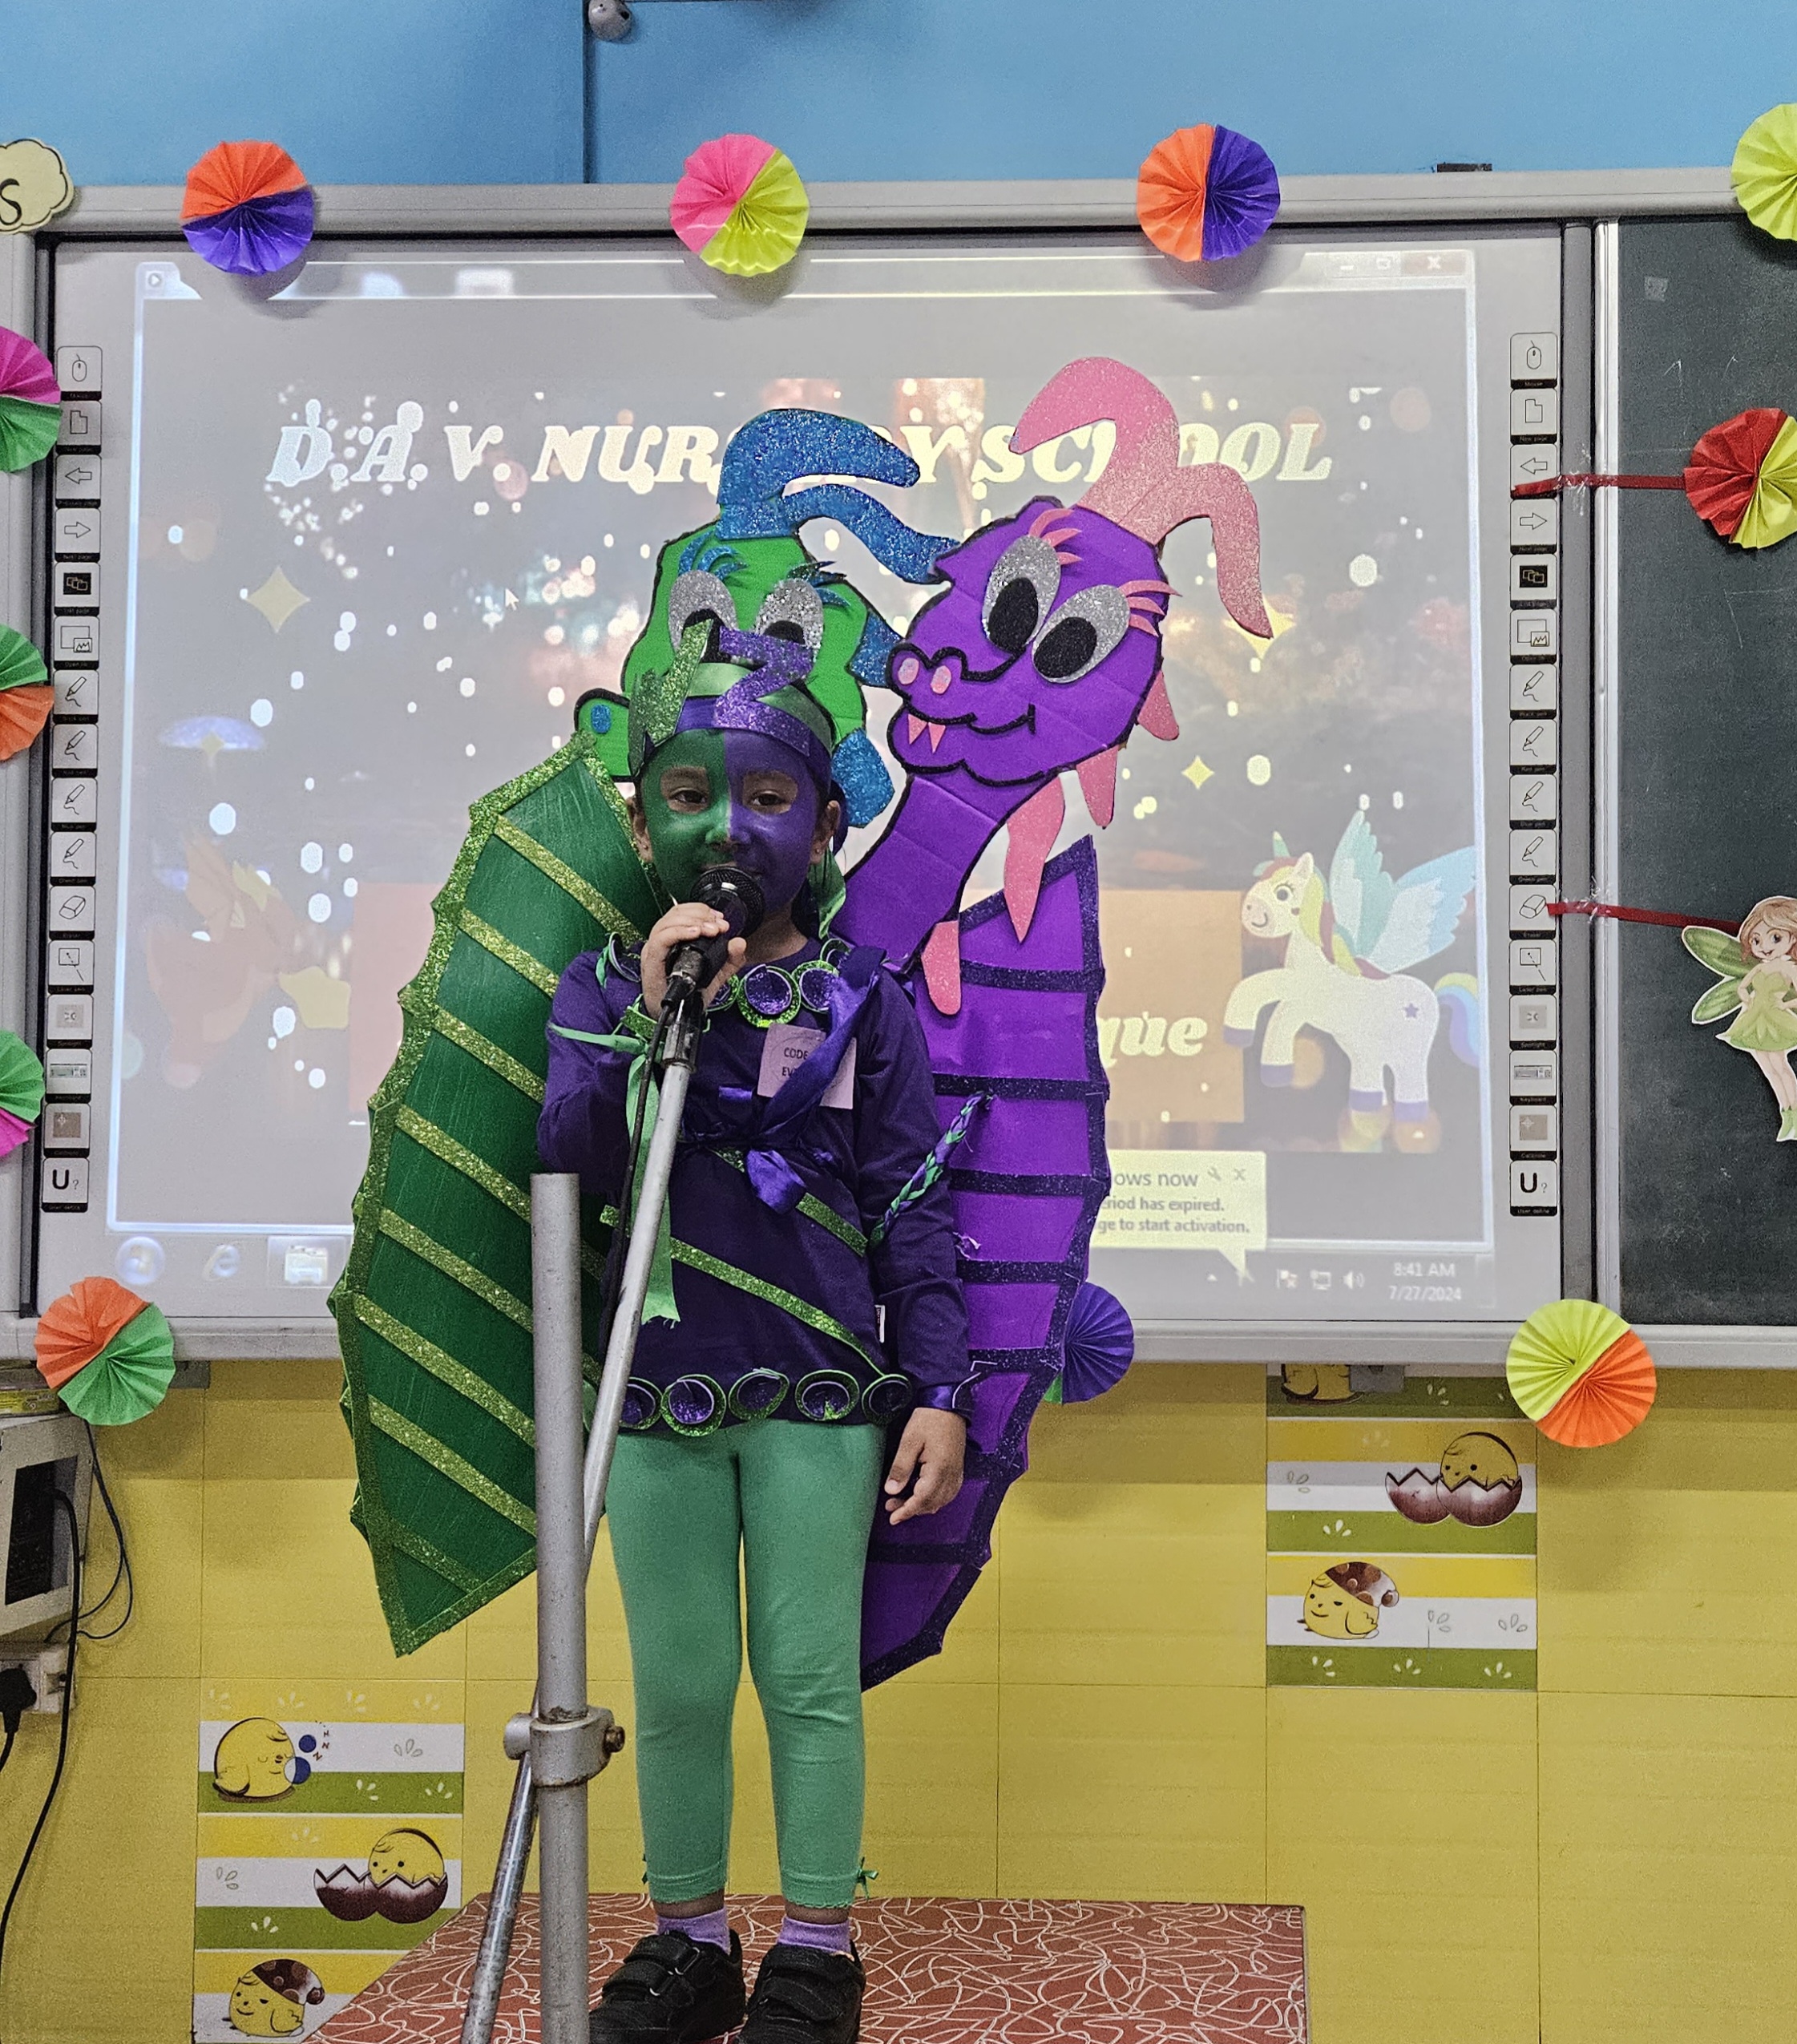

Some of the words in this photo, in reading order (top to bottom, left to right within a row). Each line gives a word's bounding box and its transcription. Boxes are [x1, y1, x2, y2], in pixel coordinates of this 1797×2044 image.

[1158, 1173, 1198, 1187] now
[1140, 1197, 1165, 1211] has
[1169, 1198, 1225, 1215] expired.
[1120, 1218, 1135, 1231] to
[1139, 1218, 1170, 1232] start
[1173, 1218, 1250, 1234] activation.
[1393, 1262, 1423, 1276] 8:41
[1428, 1262, 1456, 1278] AM
[1388, 1285, 1462, 1302] 7/27/2024
